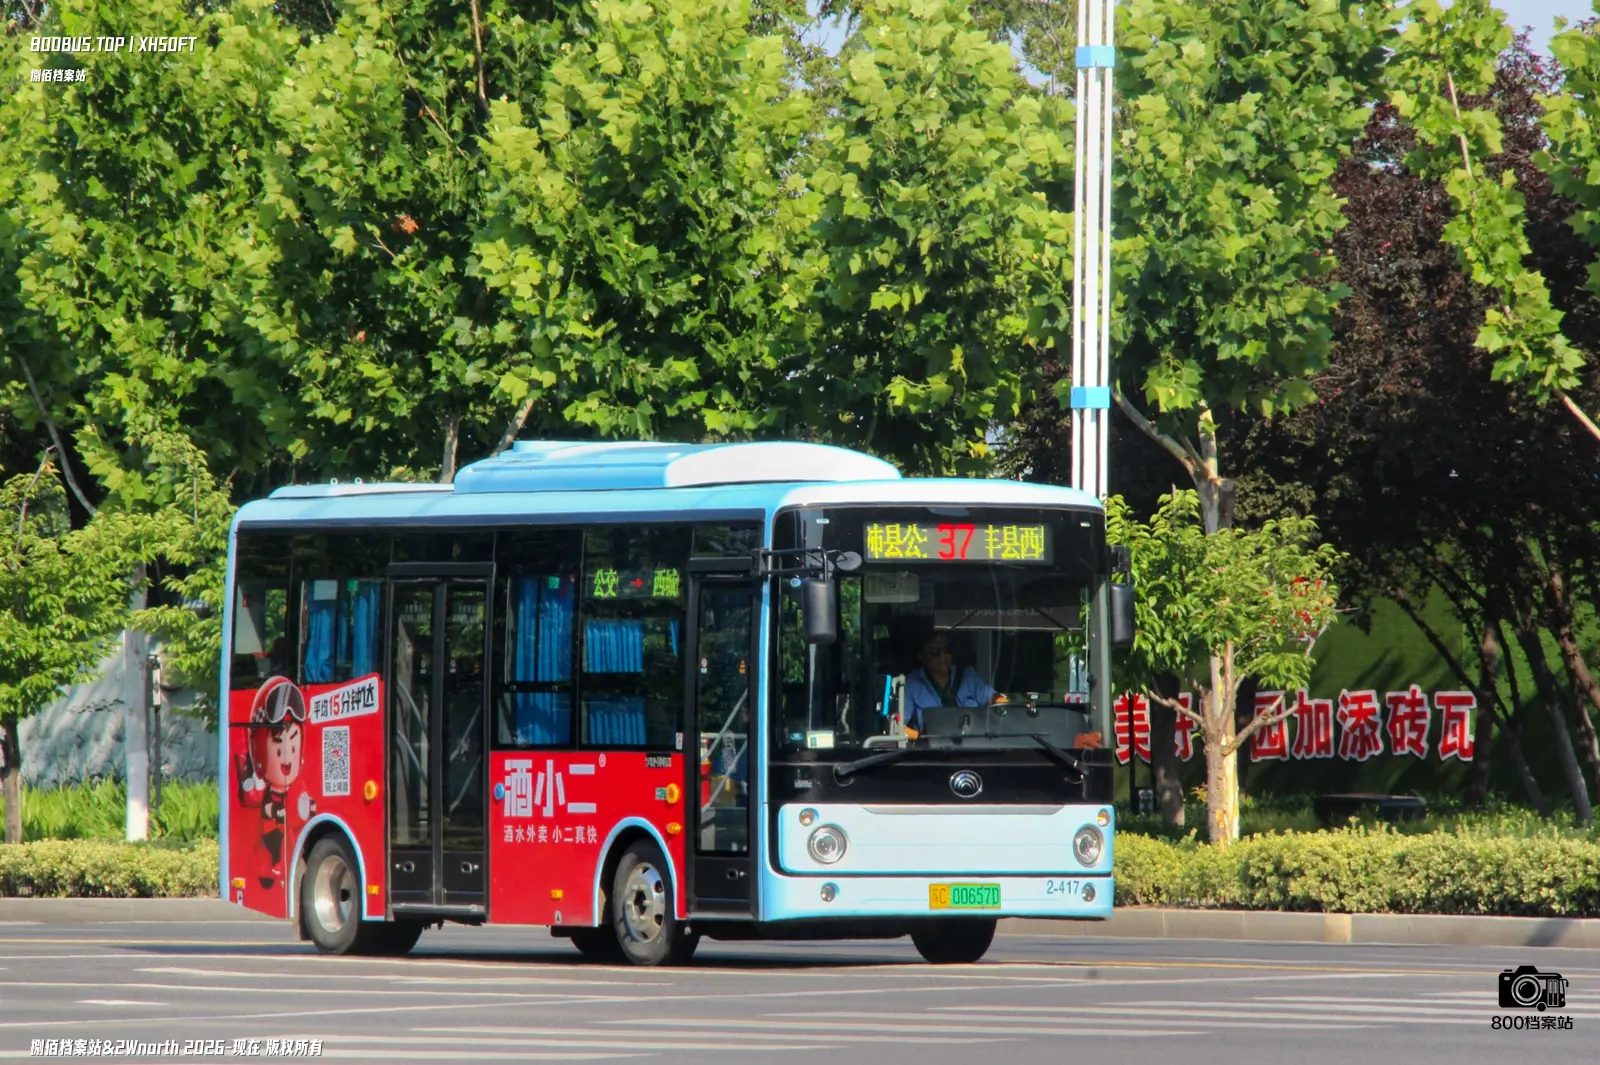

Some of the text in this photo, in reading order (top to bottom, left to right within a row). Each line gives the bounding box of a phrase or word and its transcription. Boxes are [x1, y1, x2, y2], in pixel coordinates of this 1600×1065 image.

[937, 523, 975, 560] 37
[314, 682, 375, 719] 平均15分钟达
[1113, 684, 1476, 764] 美园加添砖瓦
[503, 759, 597, 818] 酒小二
[503, 824, 598, 844] 酒水外卖 小二真快
[953, 887, 999, 905] 00657D
[1046, 880, 1080, 895] 2-417
